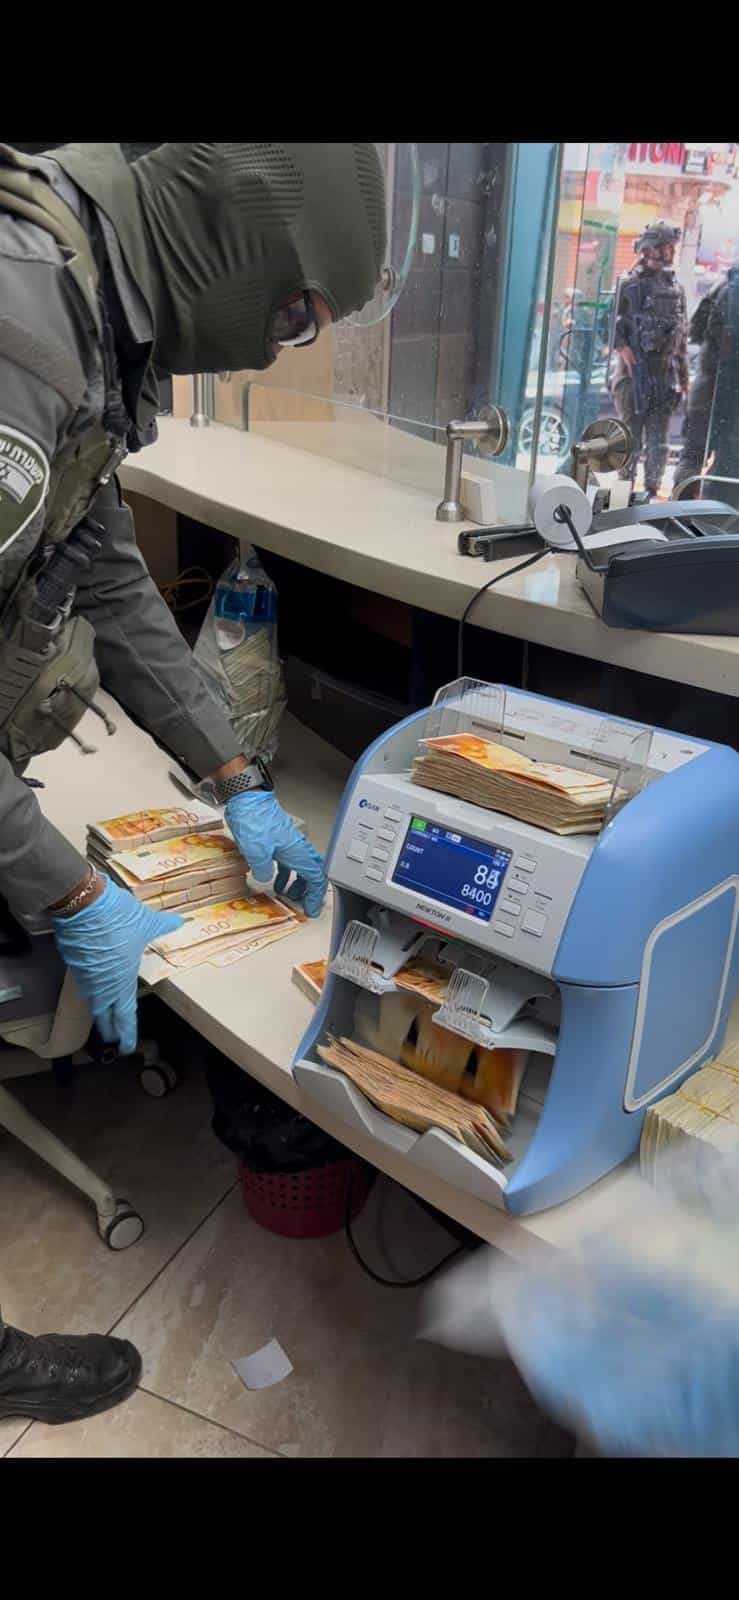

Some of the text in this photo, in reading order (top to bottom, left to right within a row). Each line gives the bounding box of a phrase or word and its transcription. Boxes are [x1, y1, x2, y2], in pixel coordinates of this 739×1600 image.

[157, 856, 188, 869] 100
[461, 884, 492, 906] 8400
[415, 903, 446, 919] NEWTON
[200, 920, 231, 935] 100
